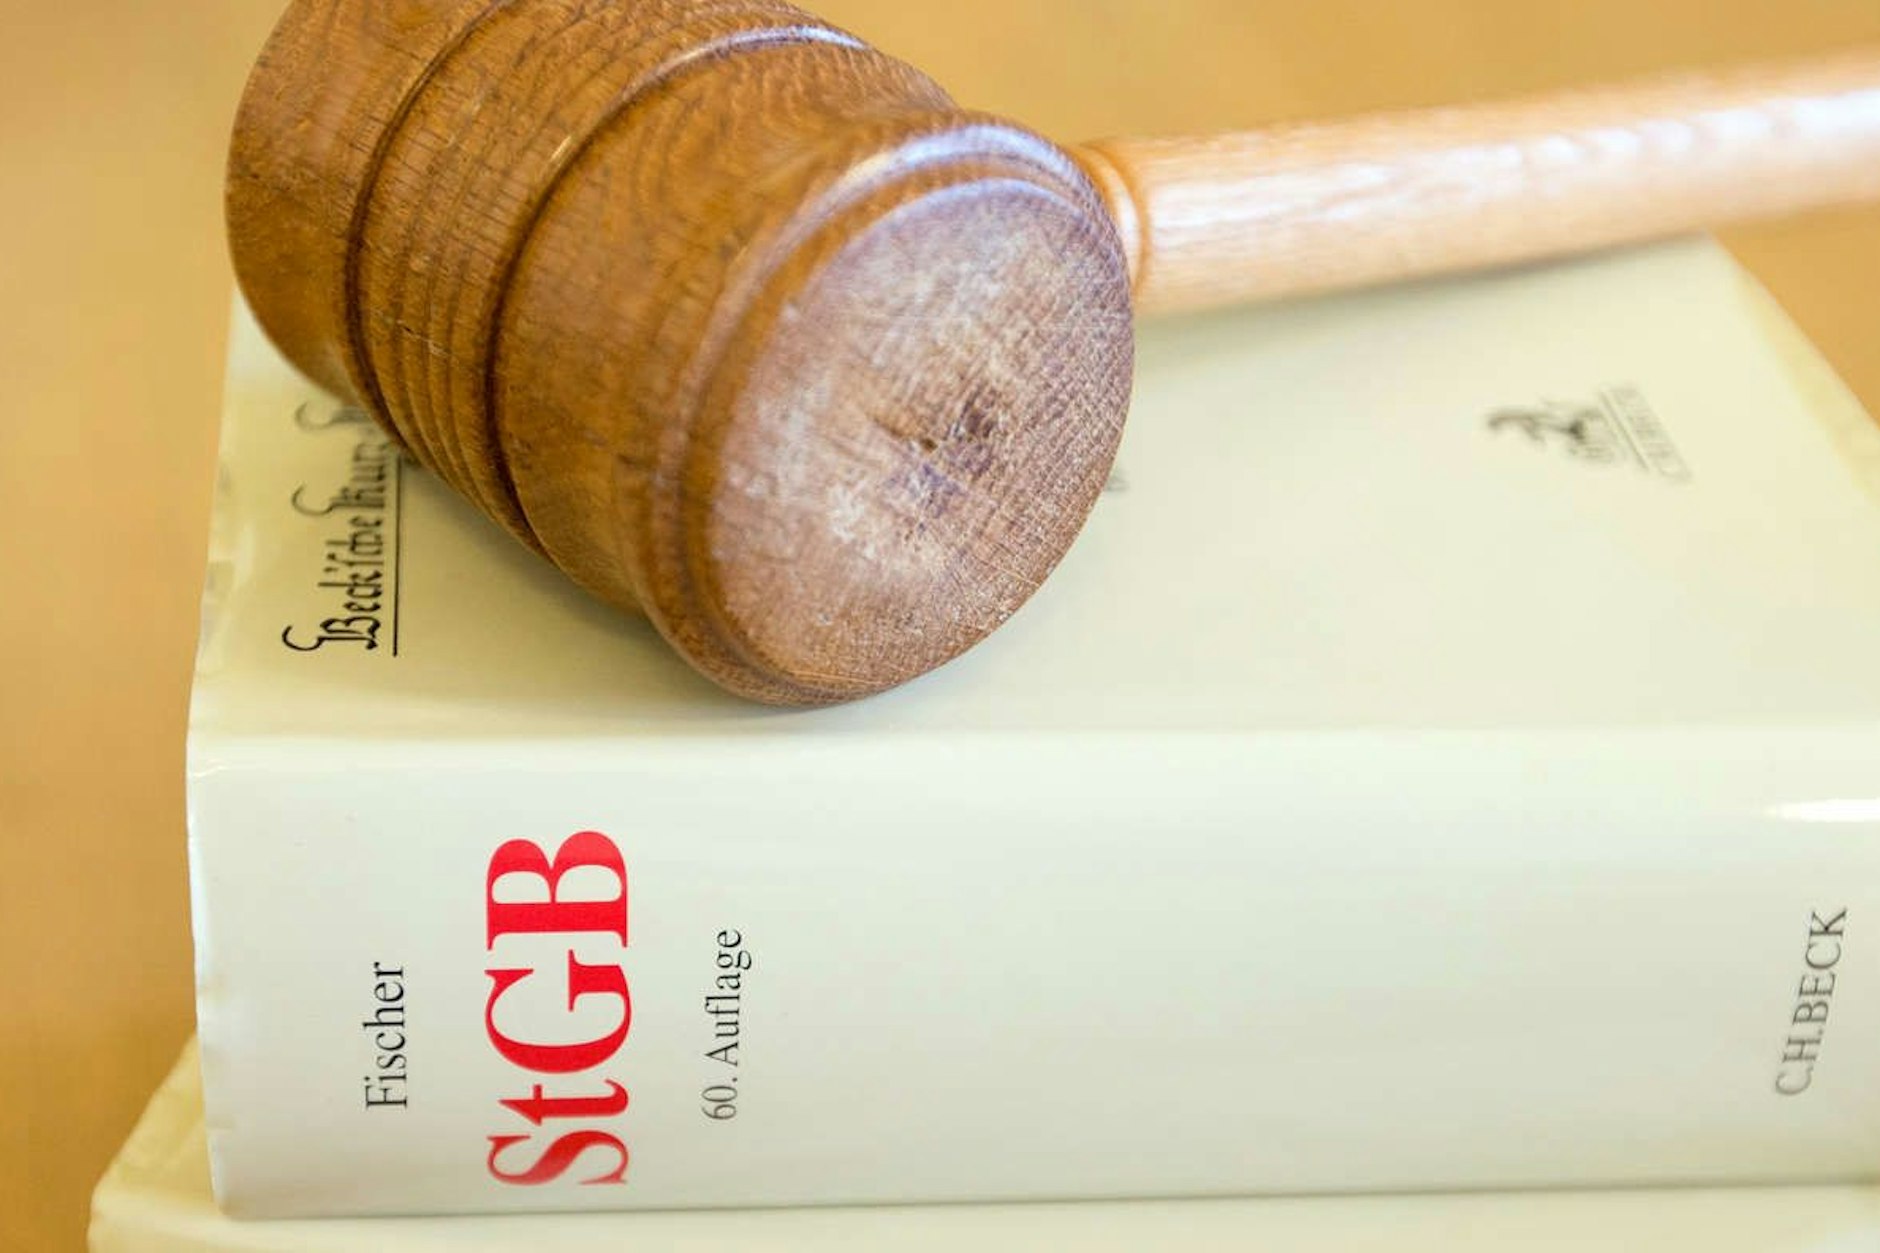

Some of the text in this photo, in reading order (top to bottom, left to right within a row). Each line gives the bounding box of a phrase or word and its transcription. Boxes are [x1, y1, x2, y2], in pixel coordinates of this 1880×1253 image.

[362, 961, 408, 1110] Fischer
[484, 830, 633, 1186] StGB
[701, 929, 752, 1121] 60. Auflage
[1774, 907, 1848, 1096] C.H.BECK
